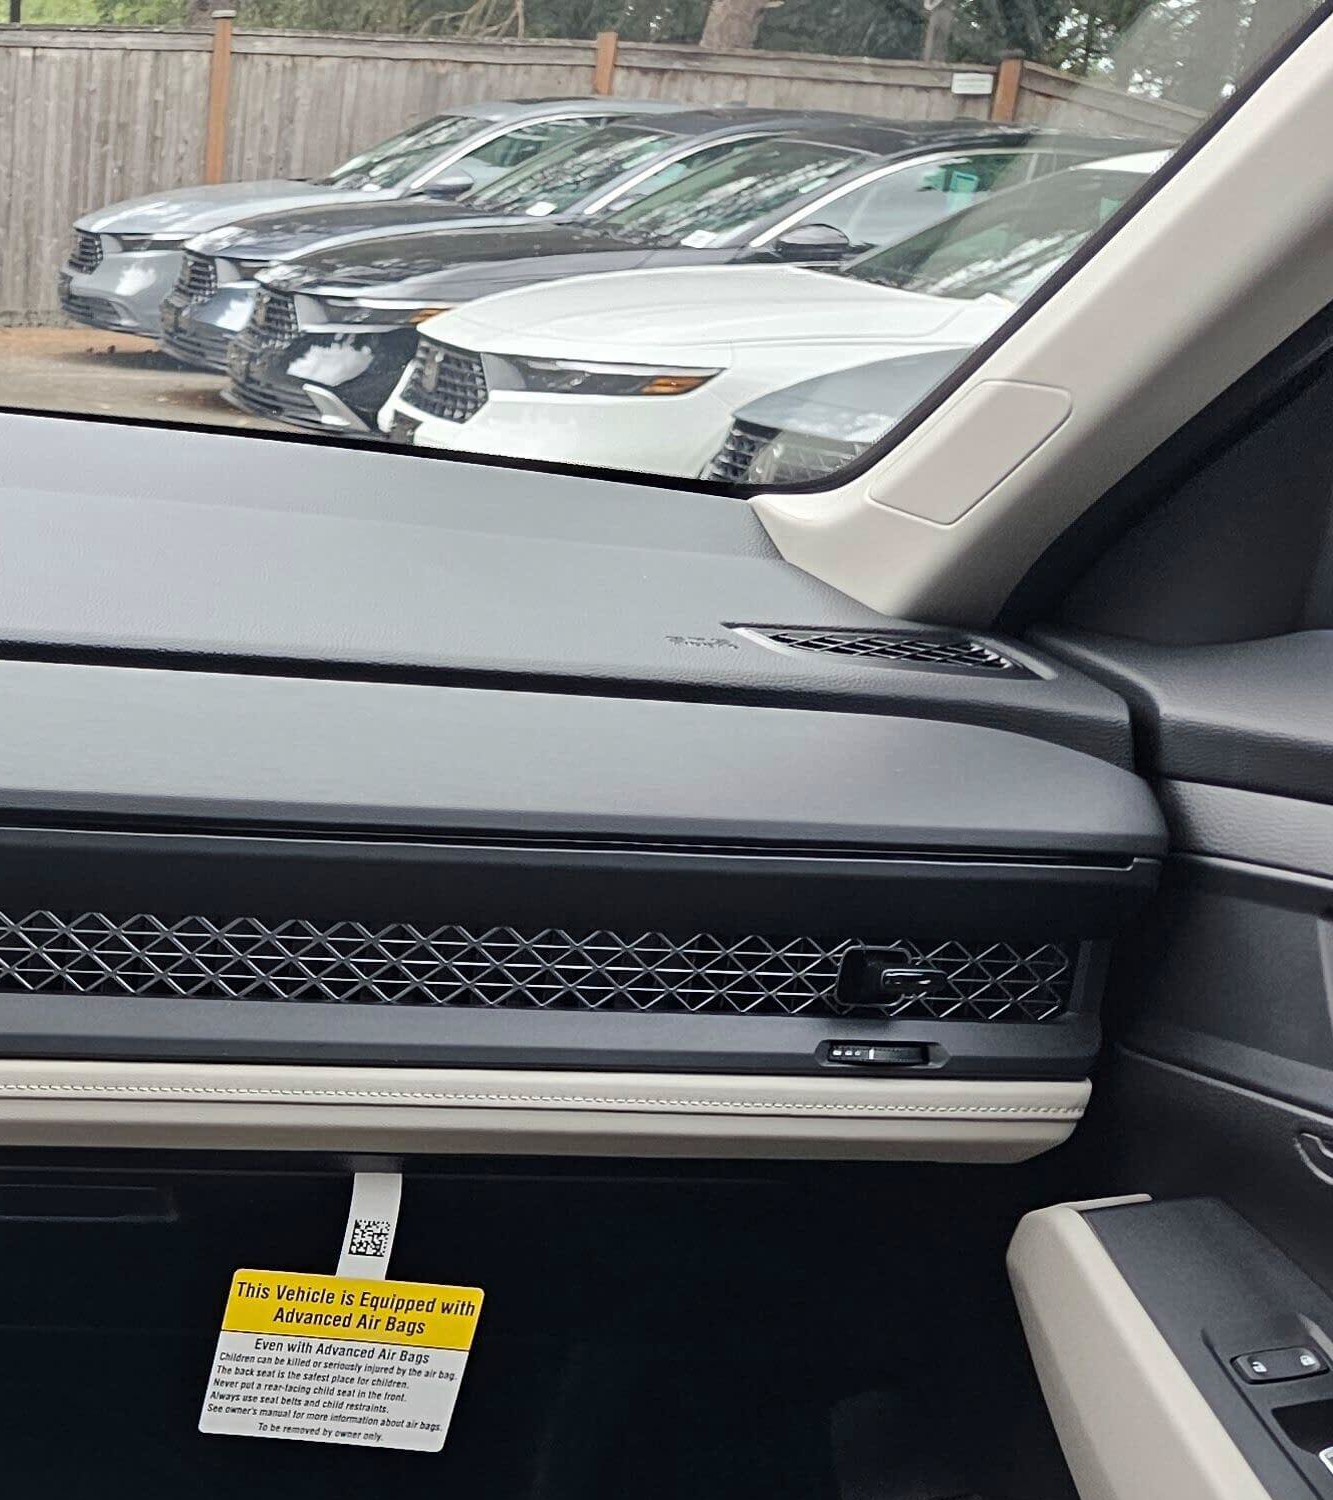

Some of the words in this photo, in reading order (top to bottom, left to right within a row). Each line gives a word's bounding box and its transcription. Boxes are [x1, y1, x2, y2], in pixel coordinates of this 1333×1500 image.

[236, 1281, 270, 1300] This
[276, 1285, 335, 1304] Vehicle
[340, 1290, 355, 1306] is
[359, 1291, 435, 1314] Equipped
[441, 1299, 475, 1316] with
[273, 1307, 351, 1328] Advanced
[356, 1315, 381, 1331] Air
[385, 1316, 426, 1336] Bags
[255, 1338, 284, 1351] Even
[287, 1341, 313, 1353] with
[316, 1343, 375, 1359] Advanced
[378, 1348, 397, 1360] Air
[399, 1350, 430, 1365] Bags
[217, 1365, 232, 1375] The
[234, 1367, 254, 1376] back
[256, 1369, 276, 1378] seat
[278, 1370, 286, 1378] is
[287, 1371, 301, 1380] the
[303, 1372, 329, 1382] safest
[331, 1375, 357, 1384] place
[357, 1376, 369, 1385] for
[371, 1377, 409, 1389] children.
[219, 1352, 255, 1362] Children
[257, 1355, 272, 1364] can
[274, 1356, 285, 1365] be
[286, 1357, 311, 1367] killed
[313, 1360, 322, 1368] or
[323, 1361, 362, 1373] seriously
[364, 1363, 394, 1374] injured
[396, 1366, 407, 1376] by
[408, 1368, 421, 1377] the
[424, 1369, 437, 1378] air
[438, 1371, 458, 1381] bag.
[210, 1391, 240, 1402] Always
[242, 1394, 258, 1402] use
[260, 1396, 278, 1404] seat
[281, 1397, 302, 1406] belts
[304, 1398, 319, 1408] and
[322, 1400, 344, 1409] child
[346, 1402, 389, 1413] restraints.
[213, 1378, 238, 1388] Never
[240, 1381, 254, 1390] put
[264, 1383, 311, 1395] rear-facing
[313, 1386, 334, 1396] child
[336, 1388, 355, 1397] seat
[357, 1390, 366, 1398] in
[368, 1391, 381, 1400] the
[384, 1392, 406, 1402] front.
[207, 1403, 223, 1412] See
[225, 1406, 257, 1416] owner's
[259, 1409, 291, 1418] manual
[293, 1410, 304, 1419] for
[306, 1413, 328, 1421] more
[330, 1414, 378, 1426] information
[380, 1419, 404, 1428] about
[406, 1421, 418, 1429] air
[419, 1421, 443, 1432] bags.
[258, 1422, 268, 1431] To
[270, 1424, 280, 1432] be
[282, 1426, 320, 1435] removed
[323, 1428, 333, 1438] by
[335, 1429, 361, 1439] owner
[363, 1431, 383, 1441] only.
